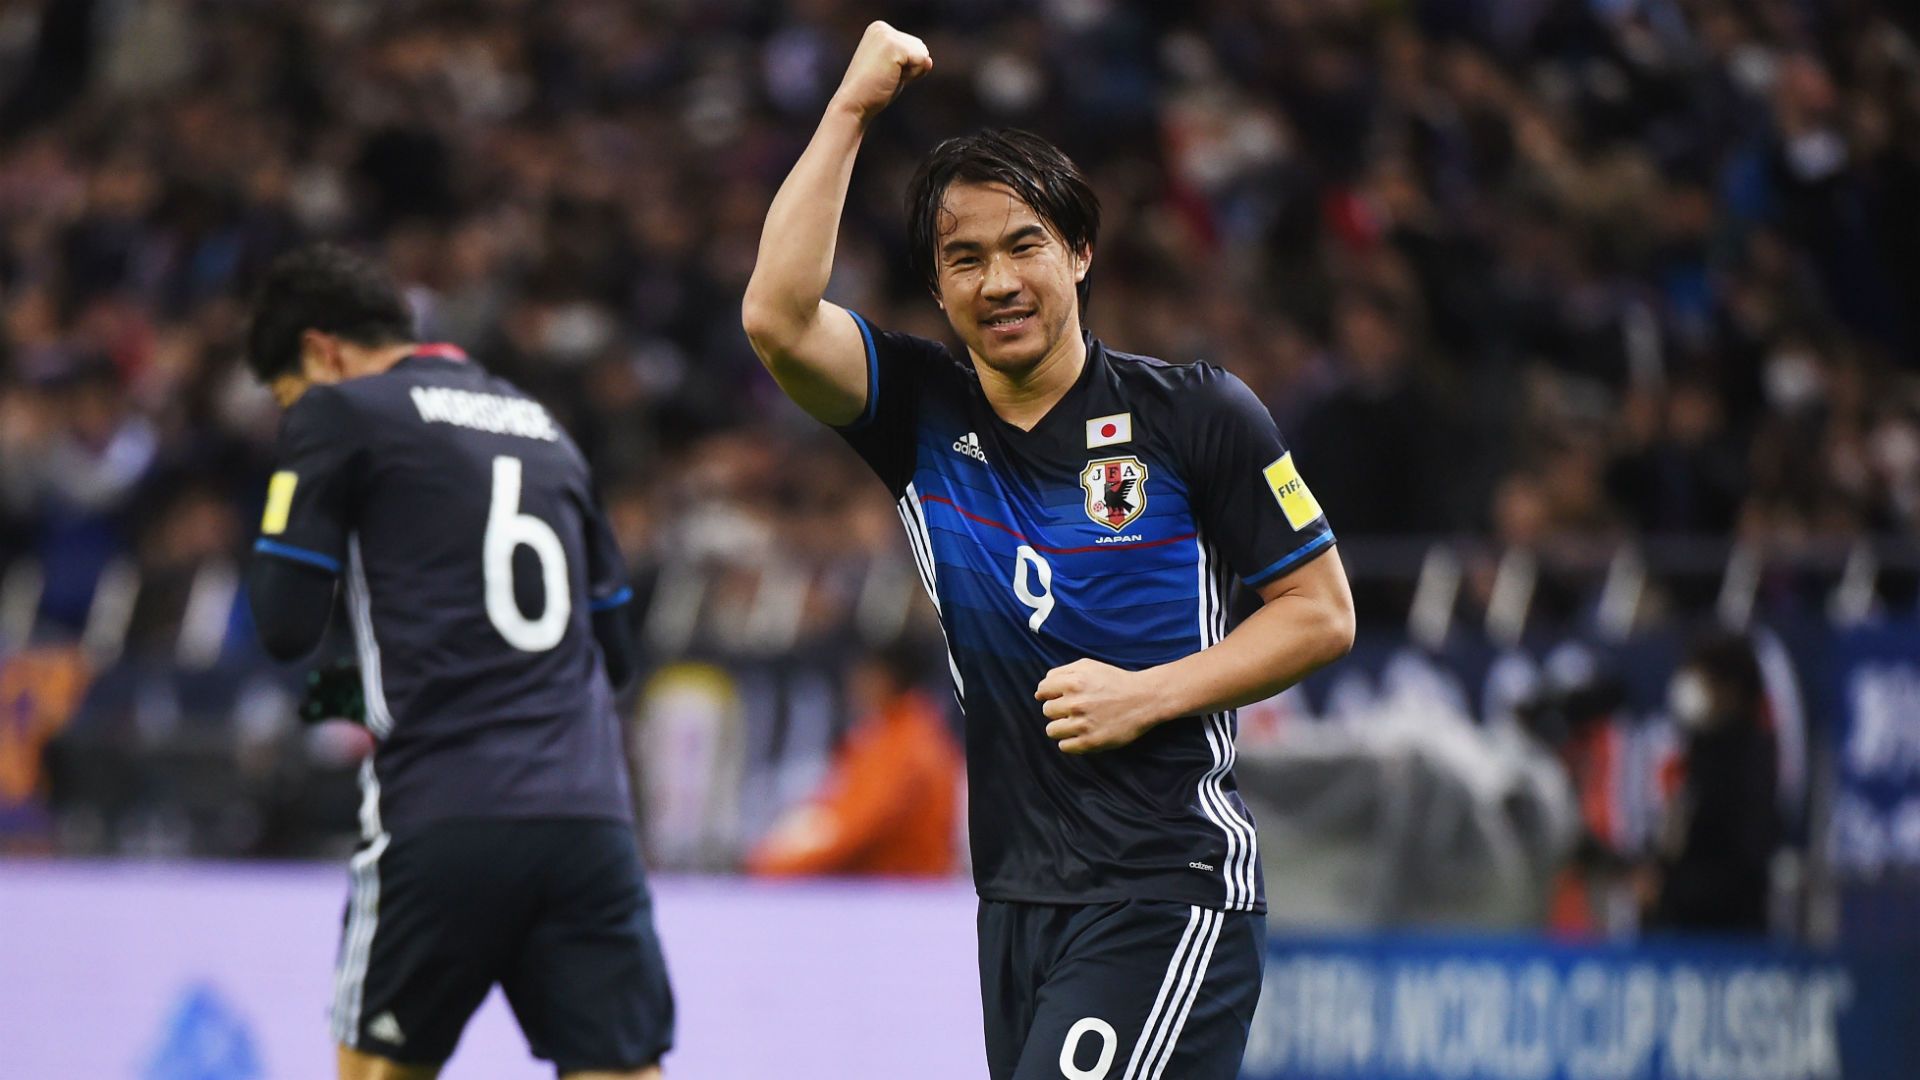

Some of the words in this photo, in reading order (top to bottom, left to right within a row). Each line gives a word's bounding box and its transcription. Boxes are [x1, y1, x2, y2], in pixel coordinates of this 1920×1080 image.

[952, 441, 989, 465] adida
[484, 455, 571, 651] 6
[1095, 534, 1142, 544] JAPAN
[1013, 545, 1054, 633] 9
